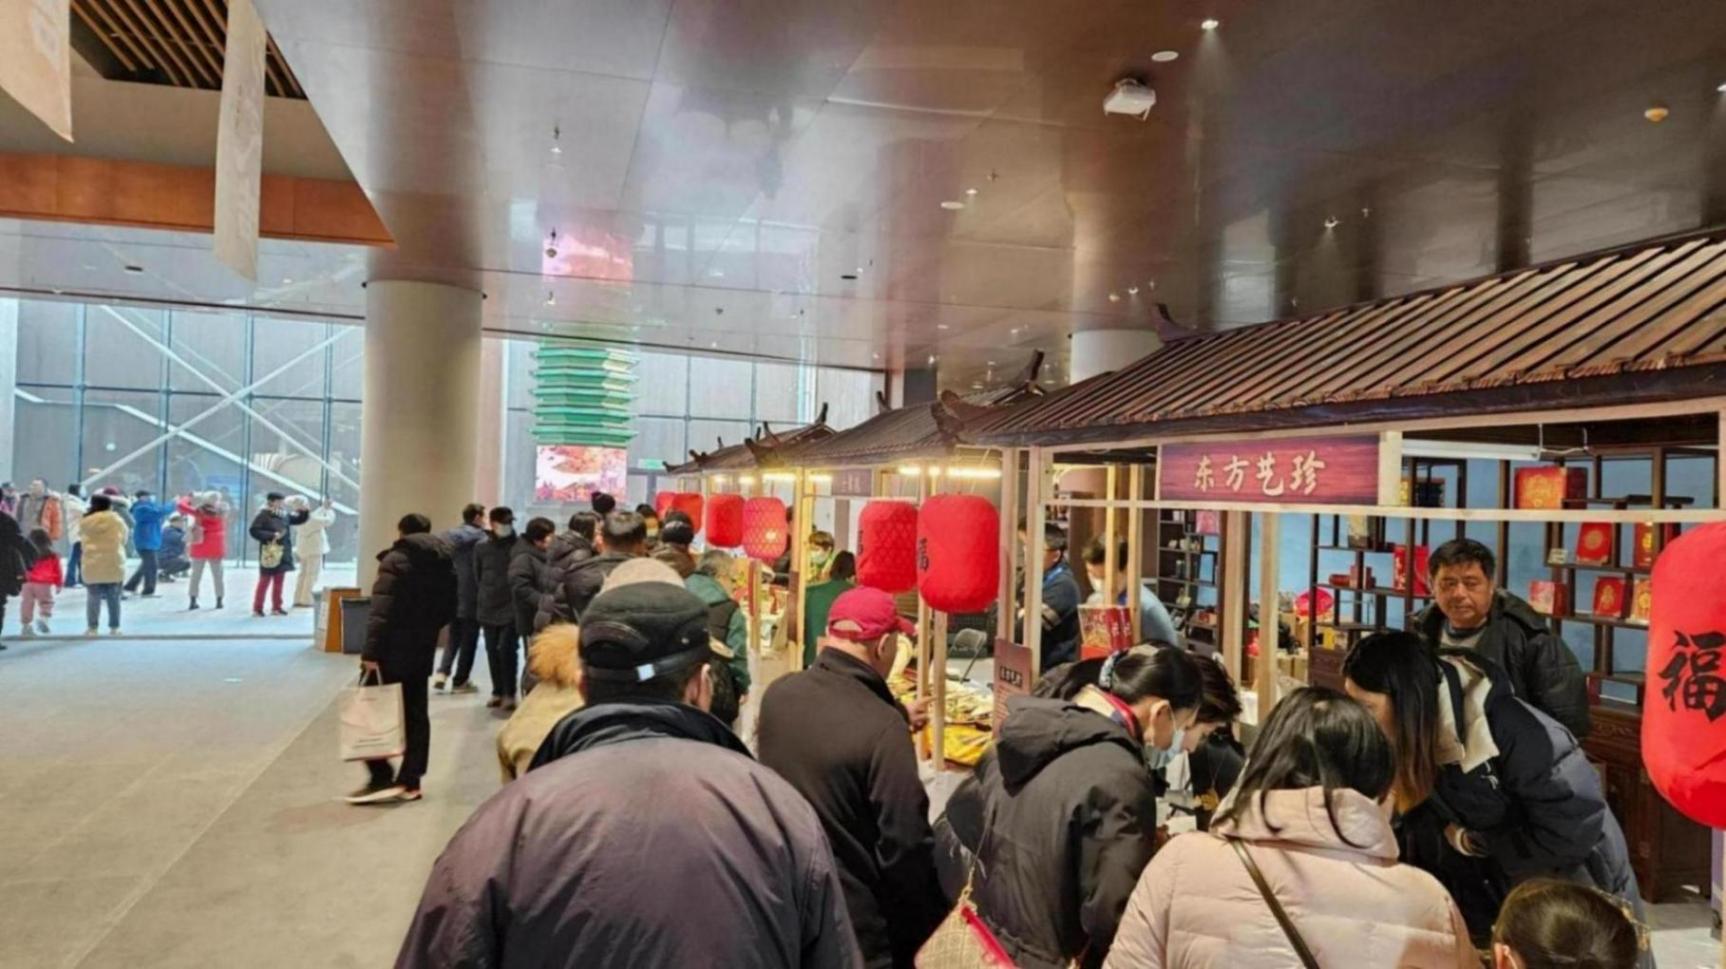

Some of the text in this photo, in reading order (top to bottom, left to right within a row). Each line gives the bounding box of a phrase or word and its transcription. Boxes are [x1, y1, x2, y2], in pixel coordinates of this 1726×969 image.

[1194, 450, 1326, 496] 东方艺珍
[1658, 629, 1726, 722] 福
